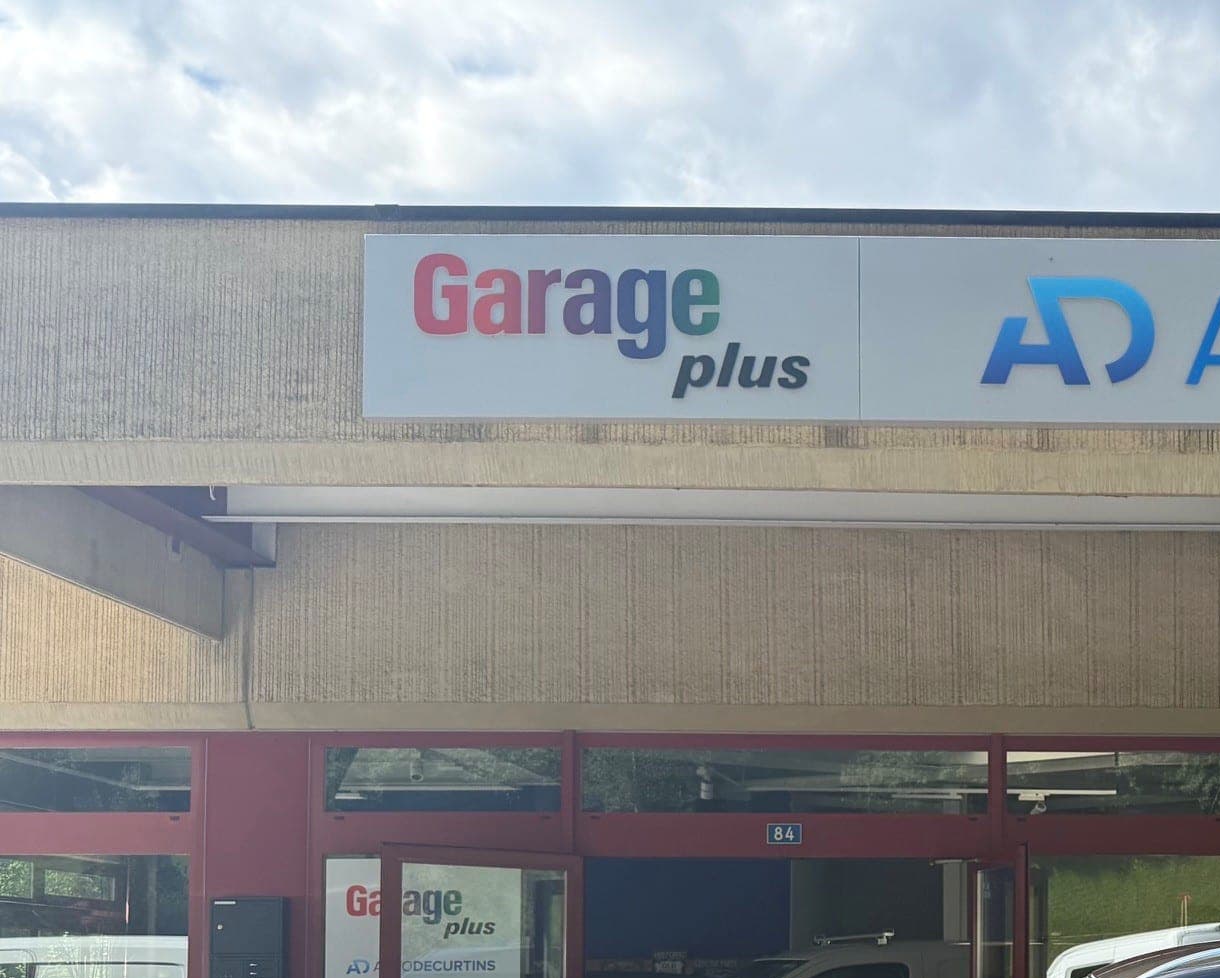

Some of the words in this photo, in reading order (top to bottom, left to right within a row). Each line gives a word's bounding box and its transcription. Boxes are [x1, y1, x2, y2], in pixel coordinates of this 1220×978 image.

[413, 252, 721, 359] Garage
[671, 341, 811, 399] plus
[774, 826, 794, 841] 84
[346, 884, 462, 925] Gaage
[443, 917, 496, 939] plus
[373, 960, 496, 973] AODECURTINS
